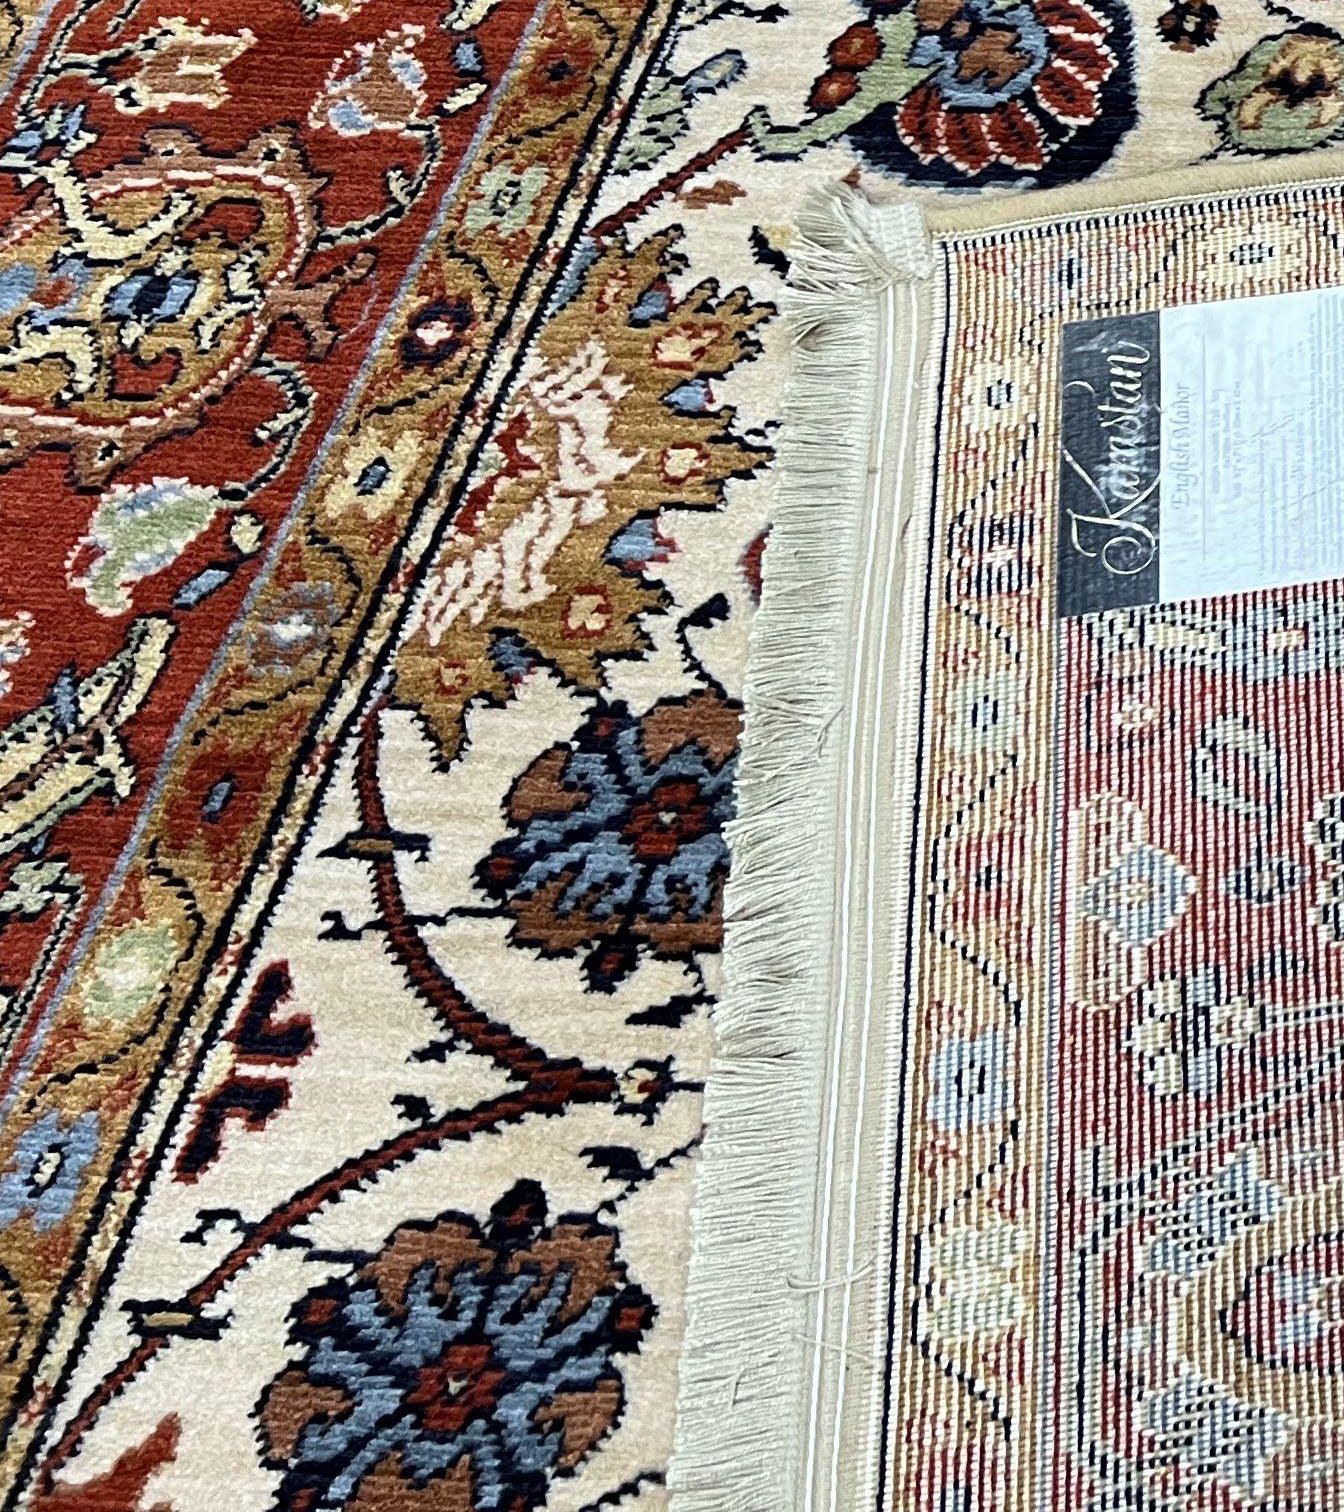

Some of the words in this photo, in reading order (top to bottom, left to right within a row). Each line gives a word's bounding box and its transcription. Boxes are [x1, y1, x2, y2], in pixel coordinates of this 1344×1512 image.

[1168, 382, 1191, 439] Manor
[1062, 341, 1160, 576] Karastan
[1168, 442, 1198, 510] English
